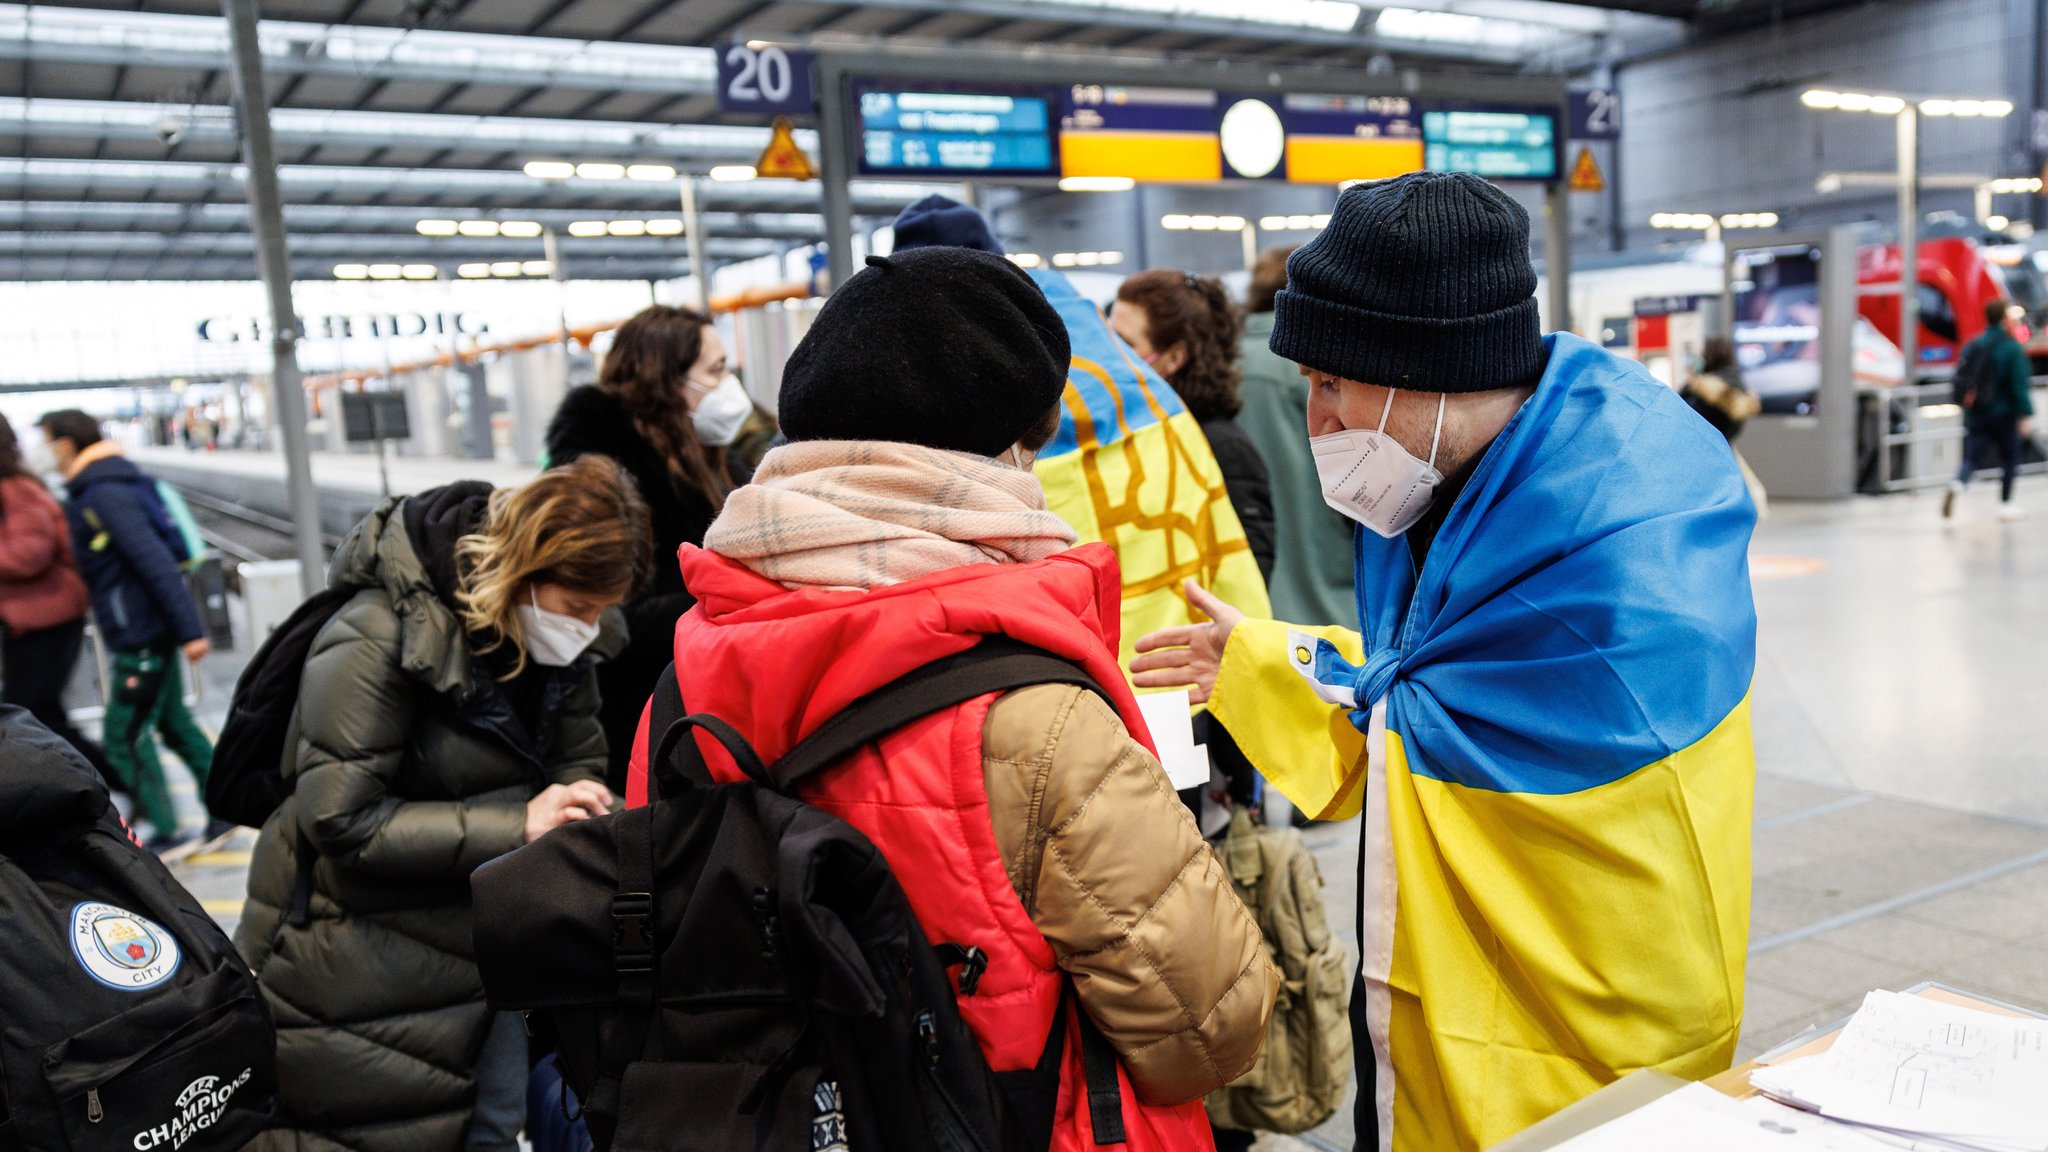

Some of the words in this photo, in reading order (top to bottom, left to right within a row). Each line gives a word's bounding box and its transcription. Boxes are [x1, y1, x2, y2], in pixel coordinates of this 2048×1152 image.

[725, 46, 792, 102] 20
[1587, 90, 1619, 131] 21
[132, 965, 162, 983] CITY
[133, 1067, 252, 1151] CHAMPIONS
[178, 1079, 214, 1107] UEFA
